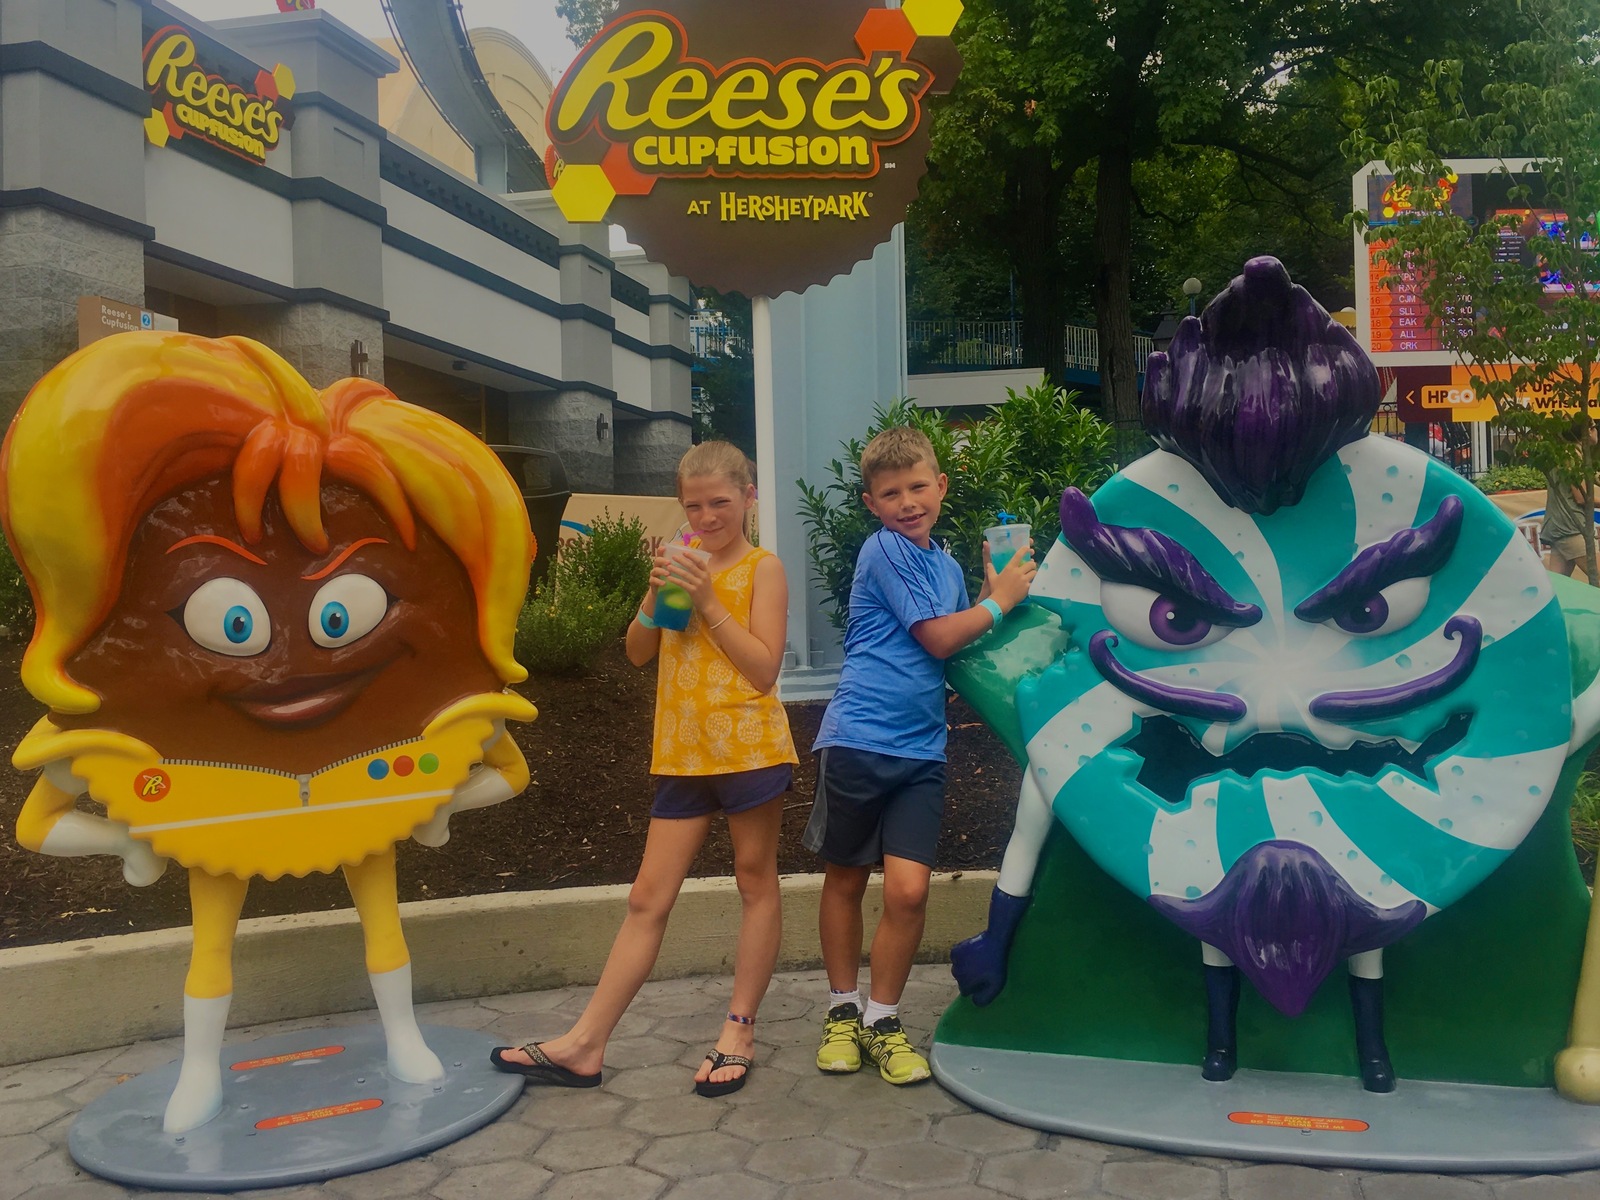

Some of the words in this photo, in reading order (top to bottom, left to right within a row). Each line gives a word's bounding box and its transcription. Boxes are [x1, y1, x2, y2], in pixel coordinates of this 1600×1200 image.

[558, 21, 920, 131] Reese's
[146, 34, 283, 143] Reese's
[687, 200, 711, 215] AT
[720, 191, 870, 221] HERSHEYPARK
[1371, 296, 1380, 304] 16
[1398, 295, 1416, 303] CJM
[101, 304, 132, 321] Reese's
[1399, 307, 1415, 315] SLL
[101, 315, 139, 331] Cupfusion
[1399, 318, 1417, 326] EAK
[1400, 330, 1416, 338] ALL
[1400, 341, 1417, 350] CRK
[1427, 389, 1474, 404] HPGO
